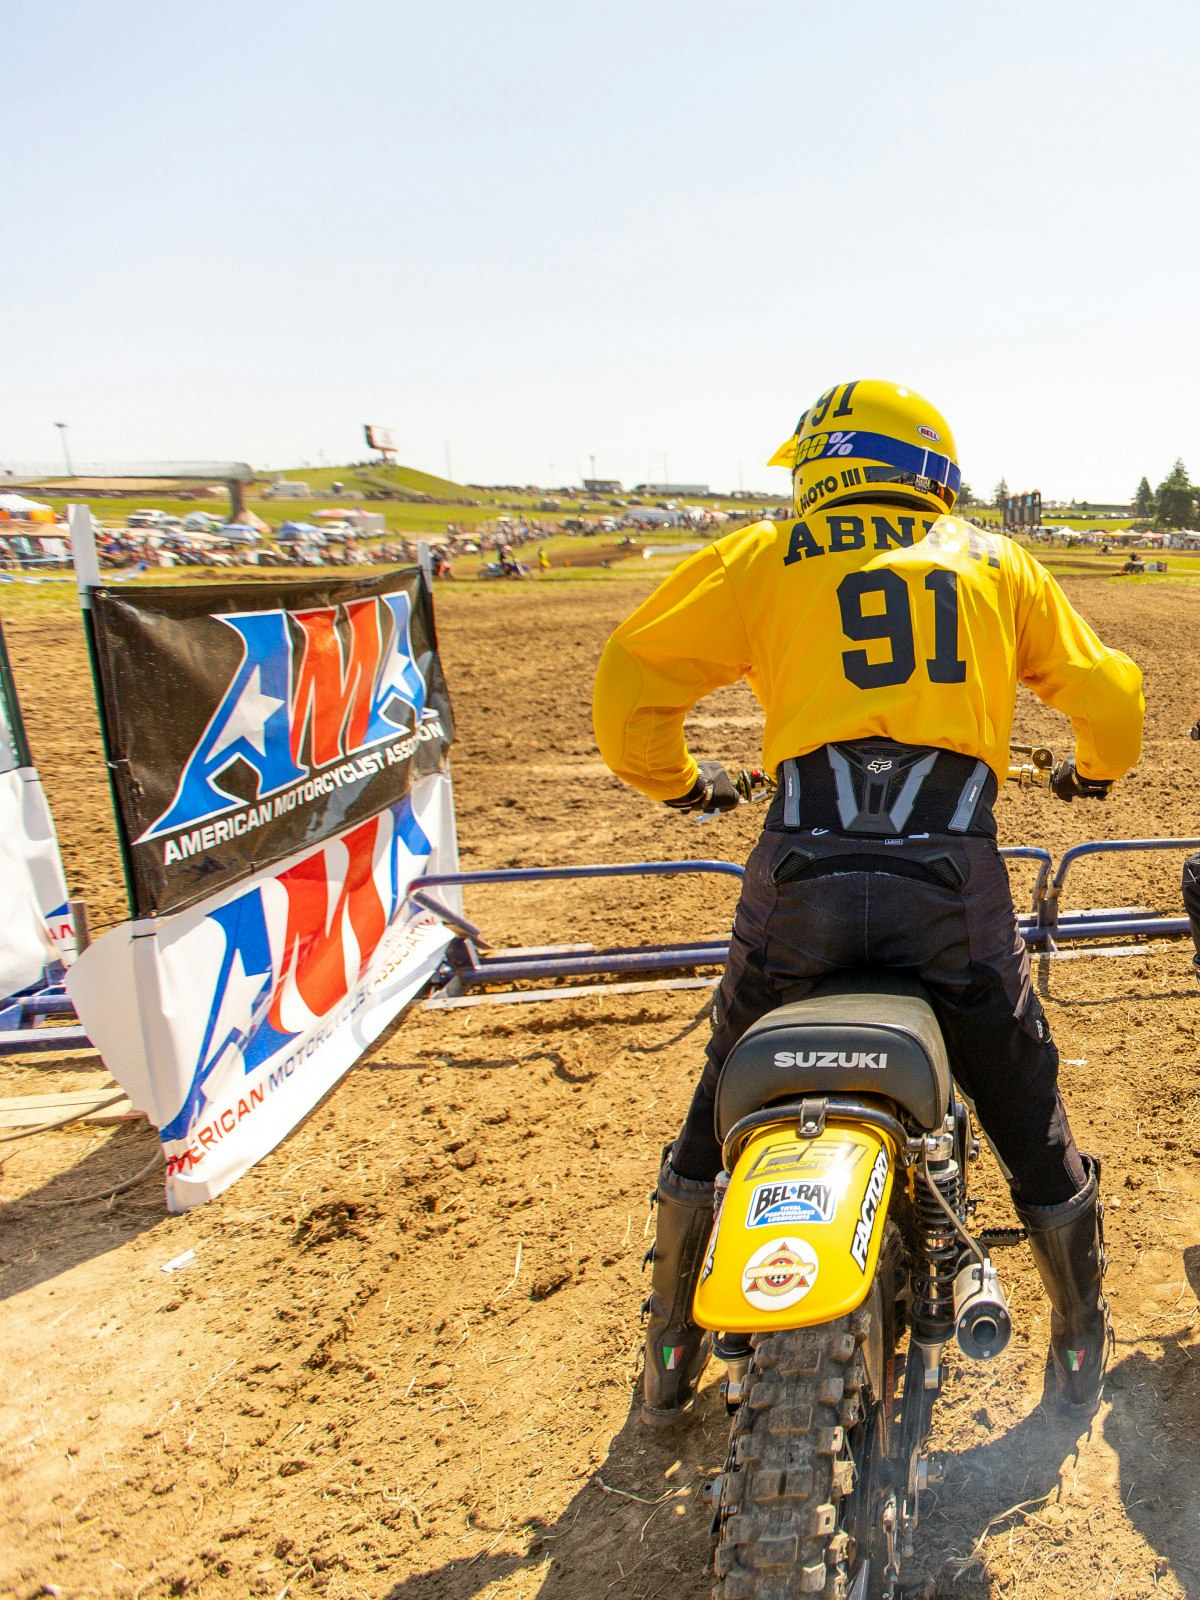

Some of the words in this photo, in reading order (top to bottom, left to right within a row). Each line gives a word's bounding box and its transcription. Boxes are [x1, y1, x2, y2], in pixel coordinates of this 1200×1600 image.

[795, 431, 857, 466] 00%
[920, 427, 938, 440] BELL
[800, 475, 838, 512] MOTO
[840, 467, 862, 488] III
[836, 568, 967, 691] 91
[130, 590, 427, 846] AMA
[164, 801, 273, 866] AMERICAN
[273, 751, 386, 818] MOTORCYCLIST
[384, 720, 445, 767] ASSOON
[774, 1051, 888, 1069] SUZUKI
[168, 1083, 264, 1177] ERICAN
[850, 1143, 889, 1275] FACTORY
